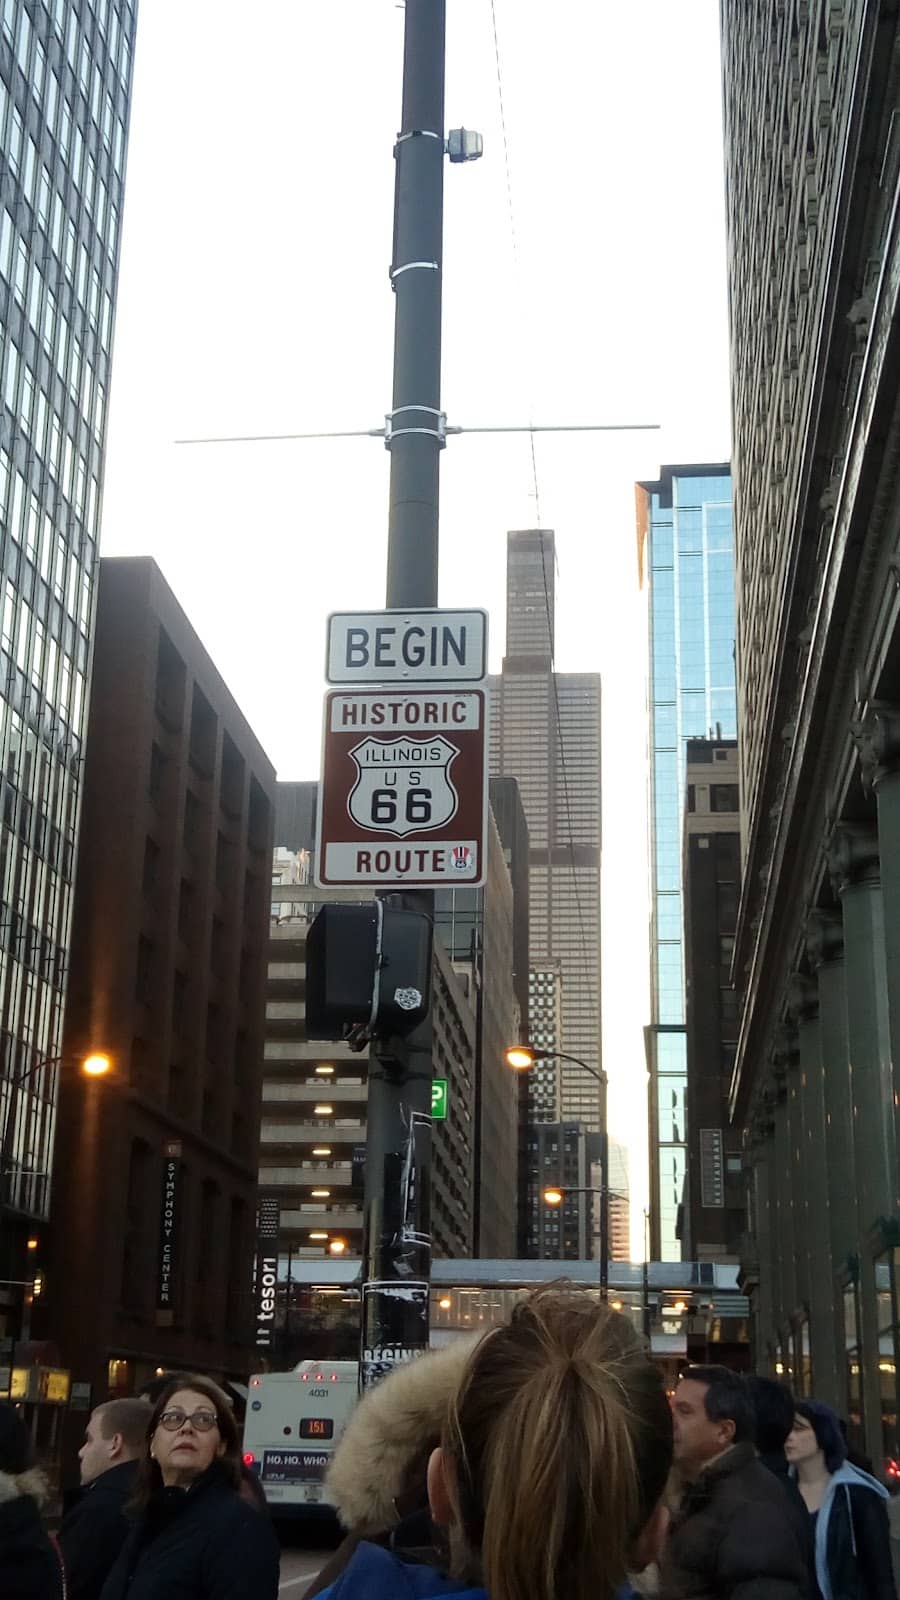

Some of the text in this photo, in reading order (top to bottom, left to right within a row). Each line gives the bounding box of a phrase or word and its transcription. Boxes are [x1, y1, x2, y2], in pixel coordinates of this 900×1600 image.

[346, 626, 466, 667] BEGIN
[342, 702, 467, 726] HISTORIC
[366, 748, 441, 762] ILLINOIS
[371, 788, 432, 824] 66
[356, 849, 446, 873] ROUTE
[161, 1162, 175, 1301] SYMPHONY CENTER
[257, 1257, 277, 1320] tesori
[309, 1389, 329, 1398] 4031
[309, 1421, 325, 1433] 151
